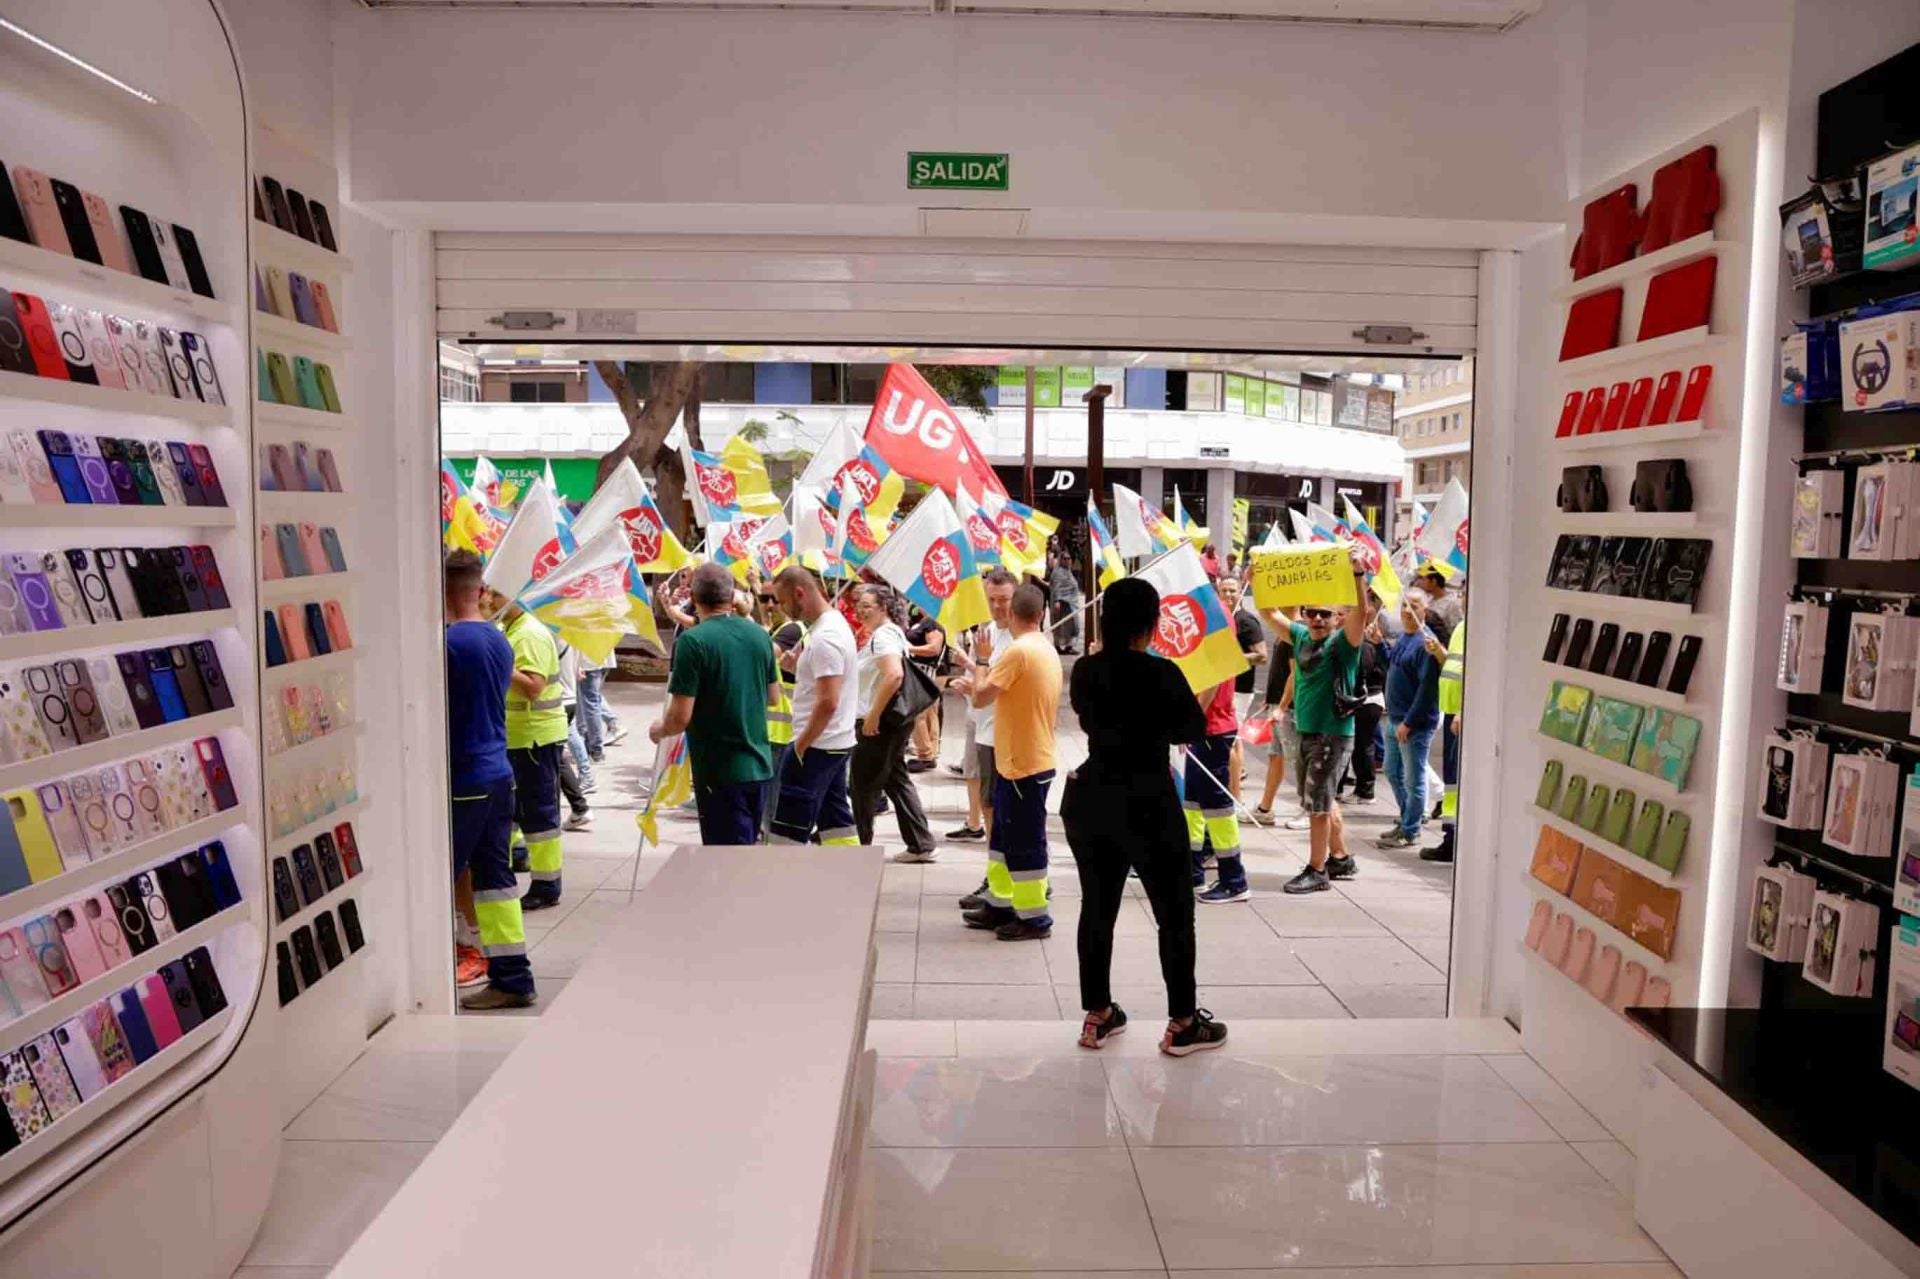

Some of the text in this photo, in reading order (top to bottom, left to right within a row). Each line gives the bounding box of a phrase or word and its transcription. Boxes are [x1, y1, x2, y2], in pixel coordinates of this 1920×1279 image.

[916, 161, 1000, 180] SALIDA
[505, 469, 518, 478] DE
[1045, 470, 1075, 490] JD
[1299, 479, 1312, 498] JD
[1256, 554, 1338, 573] SUELDOS DE
[1170, 600, 1200, 638] UGT
